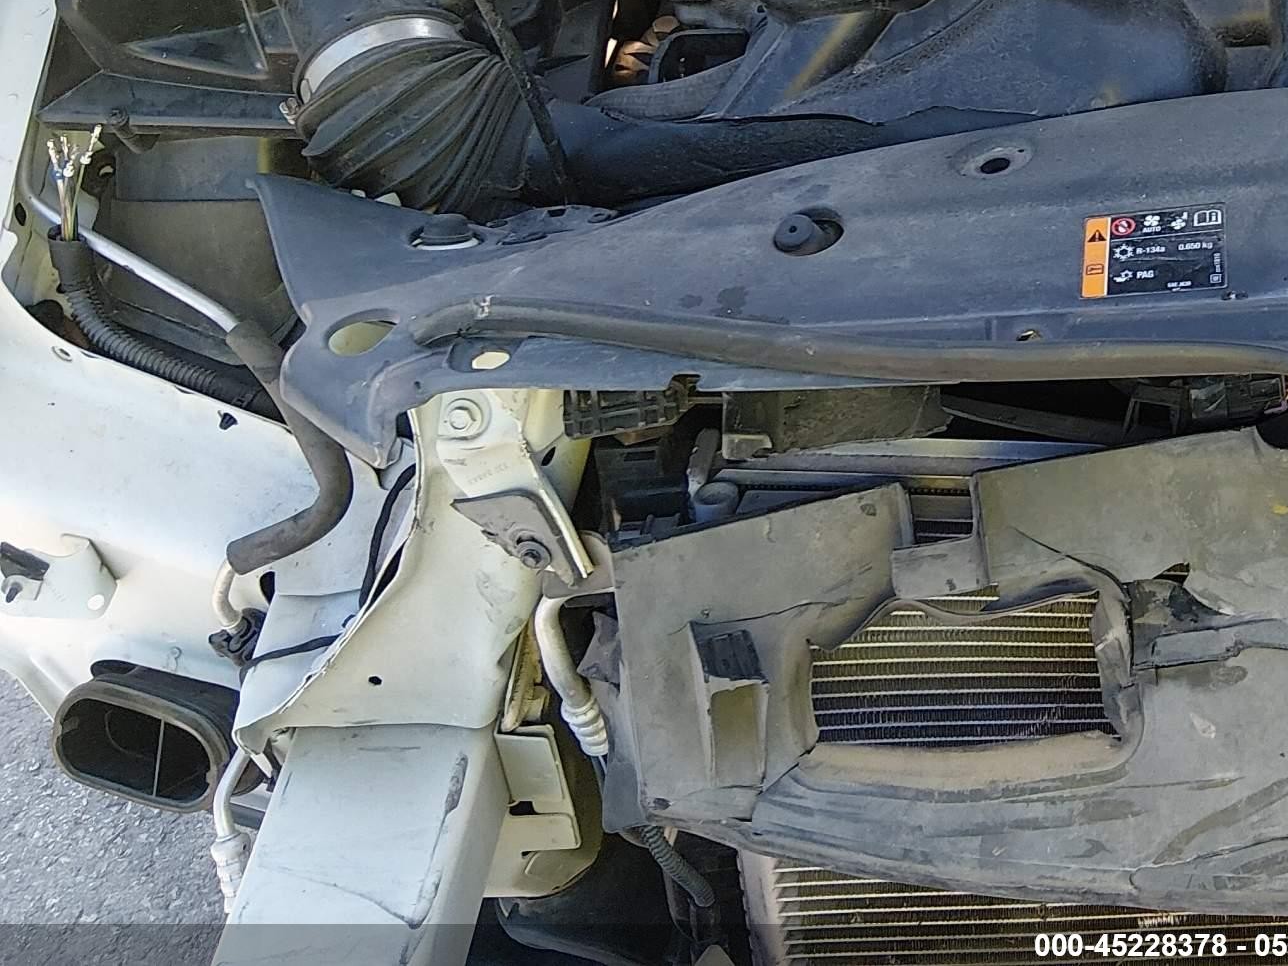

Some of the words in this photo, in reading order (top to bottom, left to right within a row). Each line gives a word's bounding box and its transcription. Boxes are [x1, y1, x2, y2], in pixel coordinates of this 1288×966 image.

[1136, 245, 1166, 254] R-134a
[1177, 242, 1201, 251] 0.650
[1201, 241, 1213, 249] kg
[1136, 270, 1154, 279] PAG
